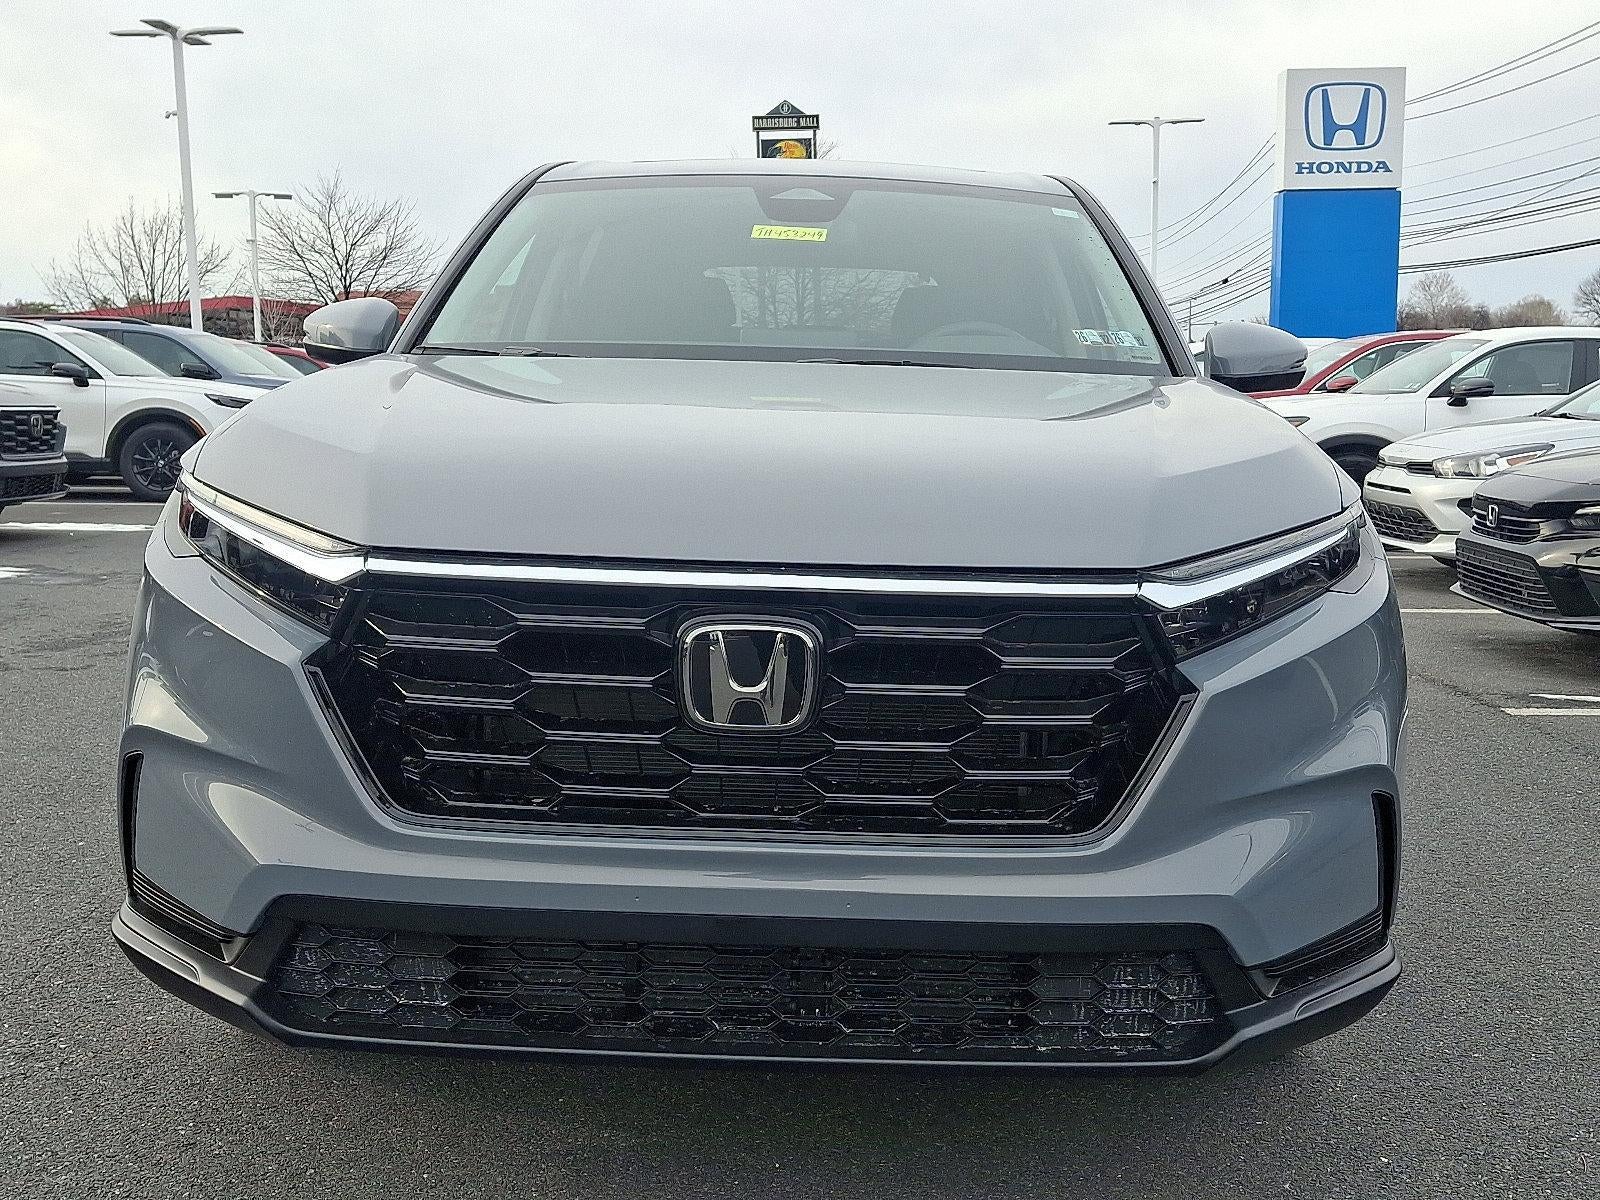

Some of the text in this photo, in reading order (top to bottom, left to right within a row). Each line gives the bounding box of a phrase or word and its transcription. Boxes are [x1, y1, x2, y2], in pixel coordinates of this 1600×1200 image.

[754, 117, 818, 128] HARRISBURG MALL
[1295, 161, 1393, 174] HONDA
